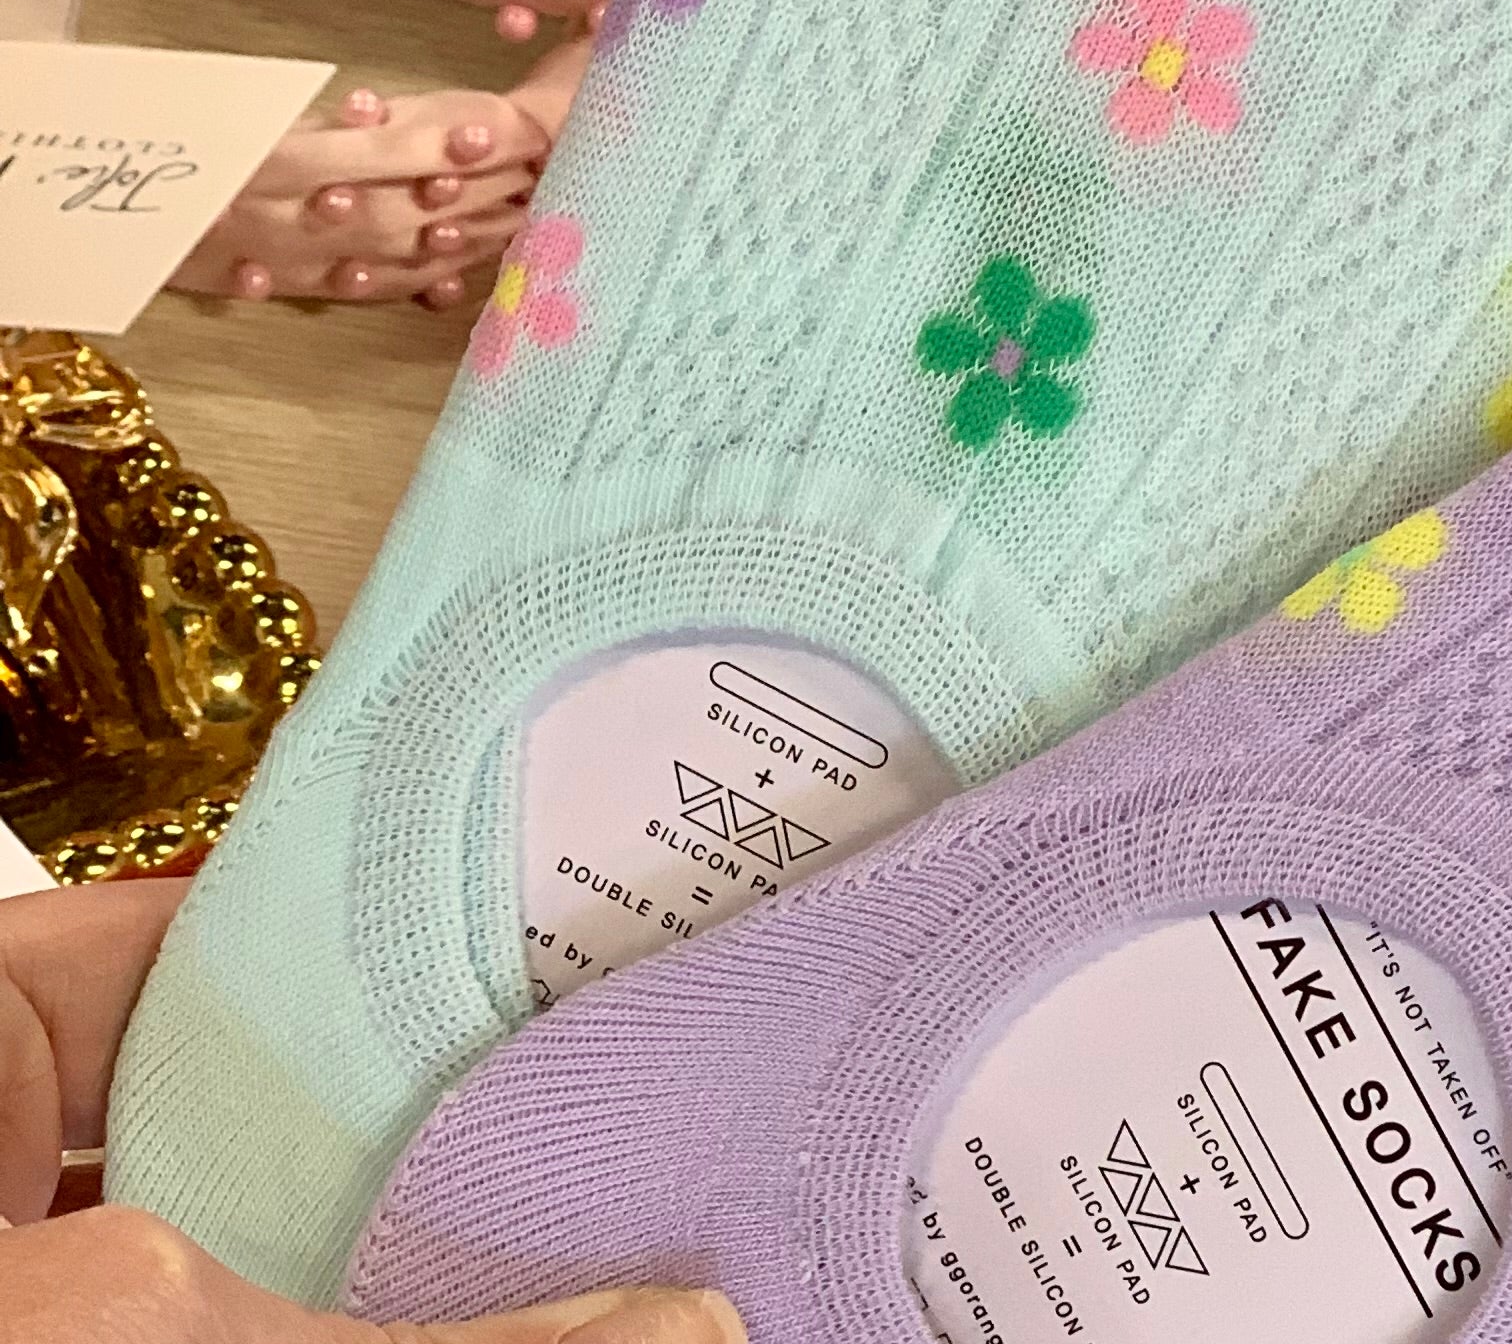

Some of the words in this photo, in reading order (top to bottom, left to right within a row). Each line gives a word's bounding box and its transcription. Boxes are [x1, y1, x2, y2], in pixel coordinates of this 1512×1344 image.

[0, 127, 187, 157] CLOTHI
[706, 701, 804, 765] SILICON
[810, 756, 858, 793] PAD
[555, 856, 654, 918] DOUBLE
[659, 910, 695, 941] SIL
[644, 818, 743, 882] SILICON
[748, 873, 779, 898] PA
[562, 941, 594, 971] by
[1239, 894, 1358, 1061] FAKE
[1341, 1078, 1483, 1293] SOCKS
[1394, 984, 1434, 1035] NOT
[1426, 1040, 1479, 1122] TAKEN
[1175, 1092, 1241, 1191] SILICON
[1232, 1196, 1268, 1244] PAD
[921, 1212, 949, 1243] by
[963, 1136, 1027, 1234] DOUBLE
[1019, 1239, 1084, 1338] SILICON
[1059, 1154, 1124, 1253] SILICON
[1114, 1257, 1152, 1306] PAD
